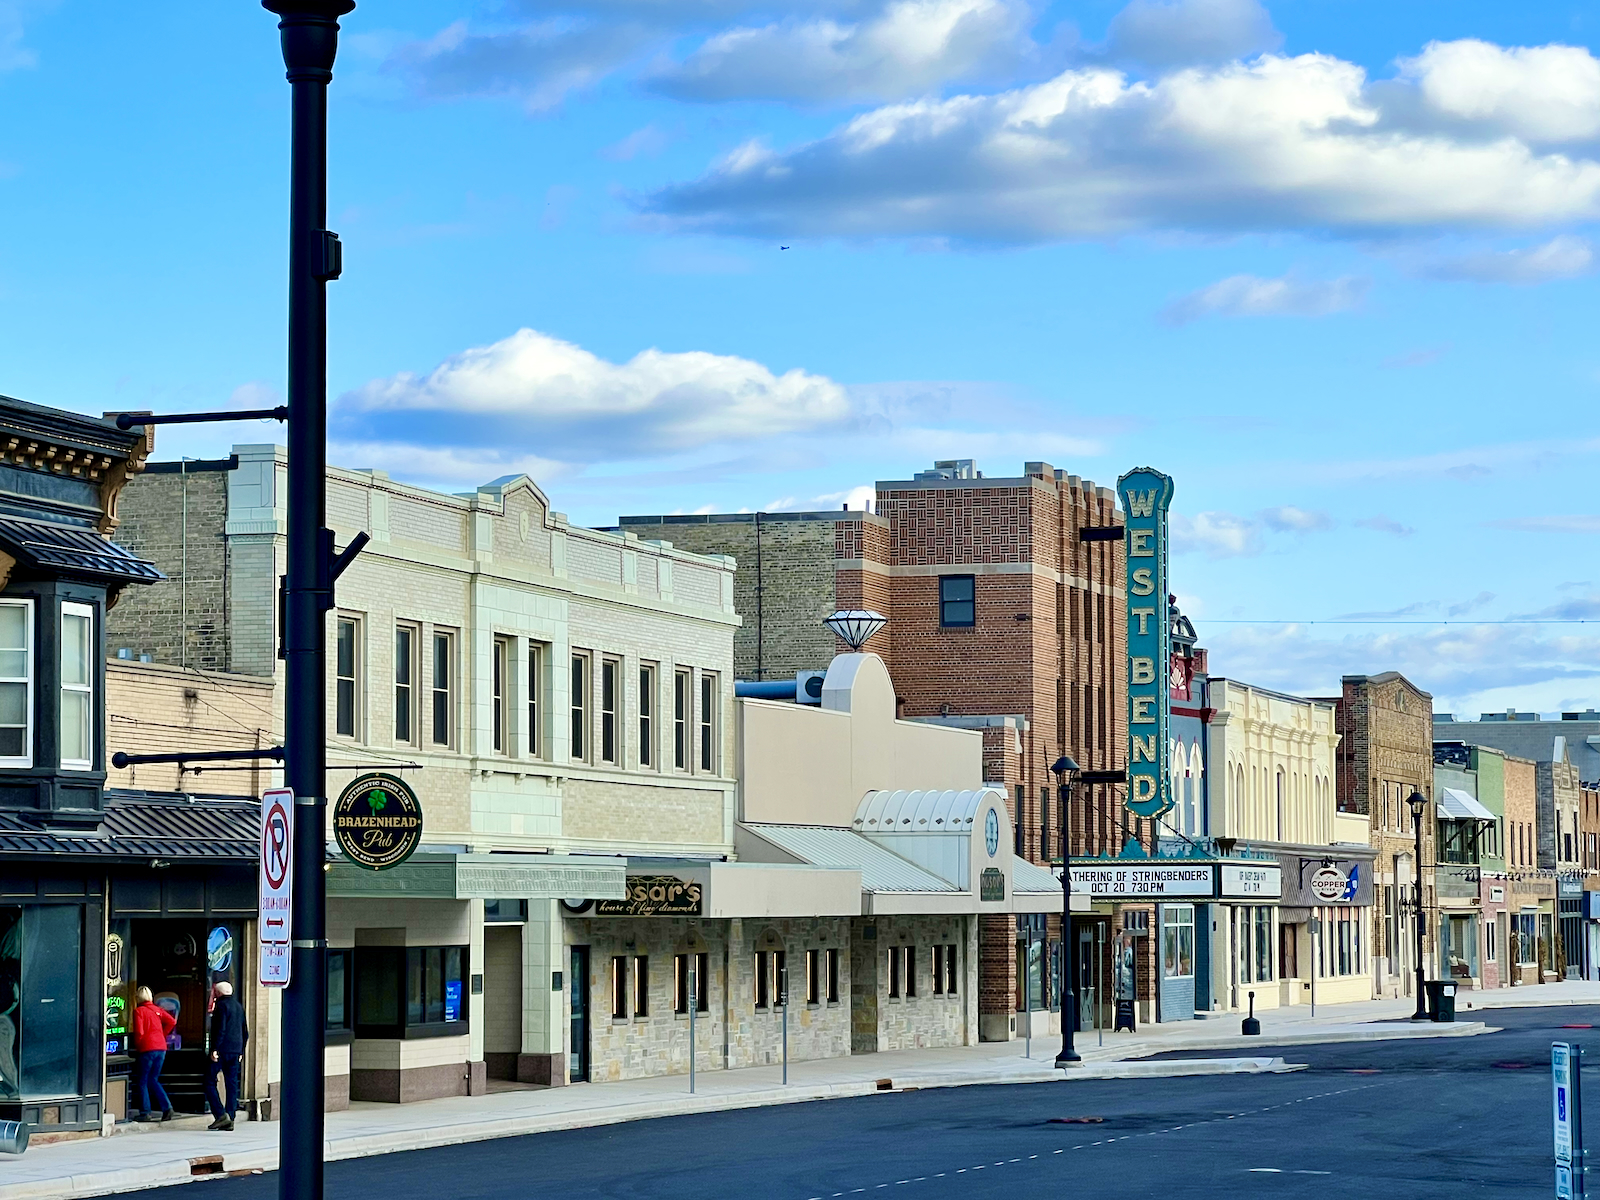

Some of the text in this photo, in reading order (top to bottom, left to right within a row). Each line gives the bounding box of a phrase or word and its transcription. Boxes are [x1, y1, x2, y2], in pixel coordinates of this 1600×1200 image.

[1126, 488, 1158, 803] WEST BEND
[346, 780, 410, 805] AUTHENTIC IRISH PUB
[338, 816, 418, 828] BRAZENHEAD
[362, 829, 393, 848] Pub
[346, 840, 408, 863] WEST BEND WISCONSIN
[1116, 871, 1127, 882] OF
[1132, 870, 1209, 882] STRINGBENDERS
[1091, 882, 1109, 893] OCT
[1113, 882, 1125, 893] 20
[1311, 880, 1345, 888] COPPER
[599, 901, 698, 914] house of fine diamonds
